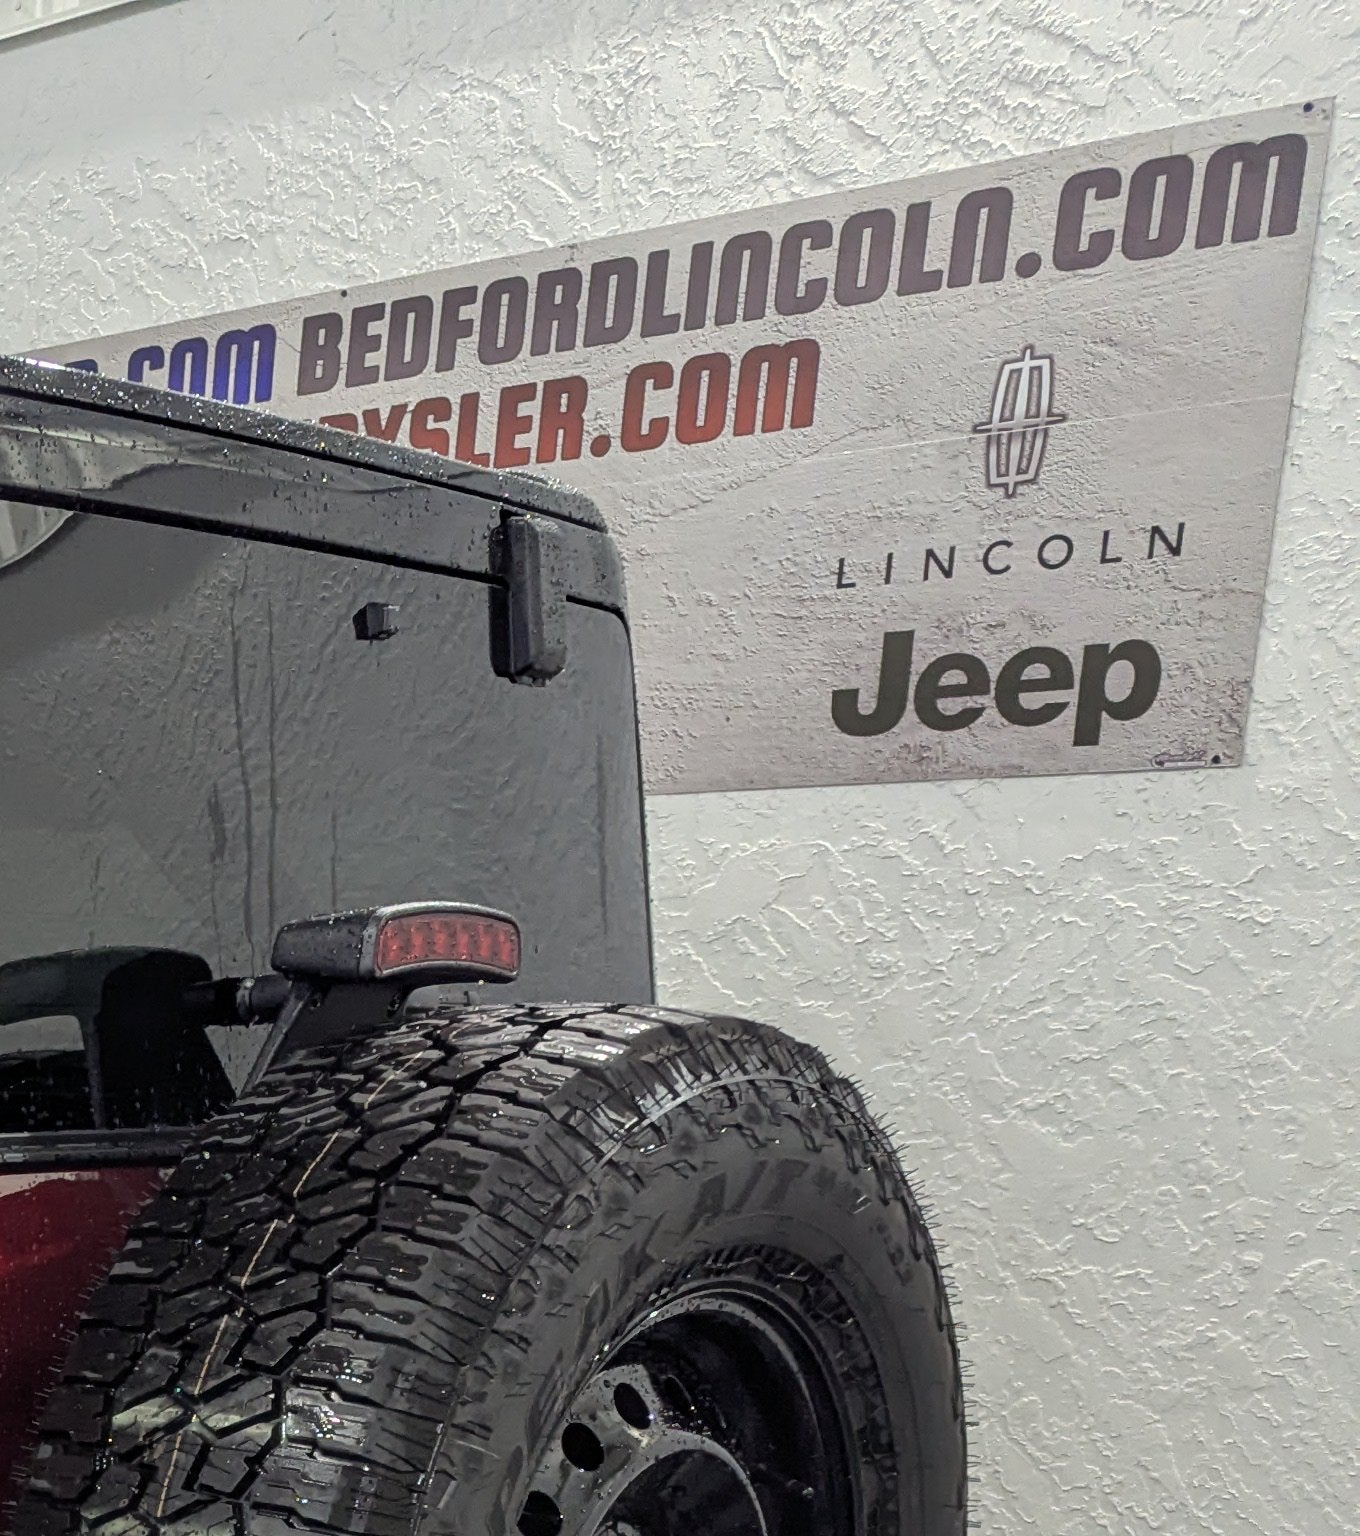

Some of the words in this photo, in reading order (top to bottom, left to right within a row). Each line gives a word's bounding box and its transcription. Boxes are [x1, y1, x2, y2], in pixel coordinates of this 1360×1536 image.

[296, 131, 1309, 396] BEDFORDLINCOLN.COM
[319, 338, 821, 469] YSLER.COM
[836, 522, 1185, 589] LINCOLN
[831, 629, 1161, 747] Jeep
